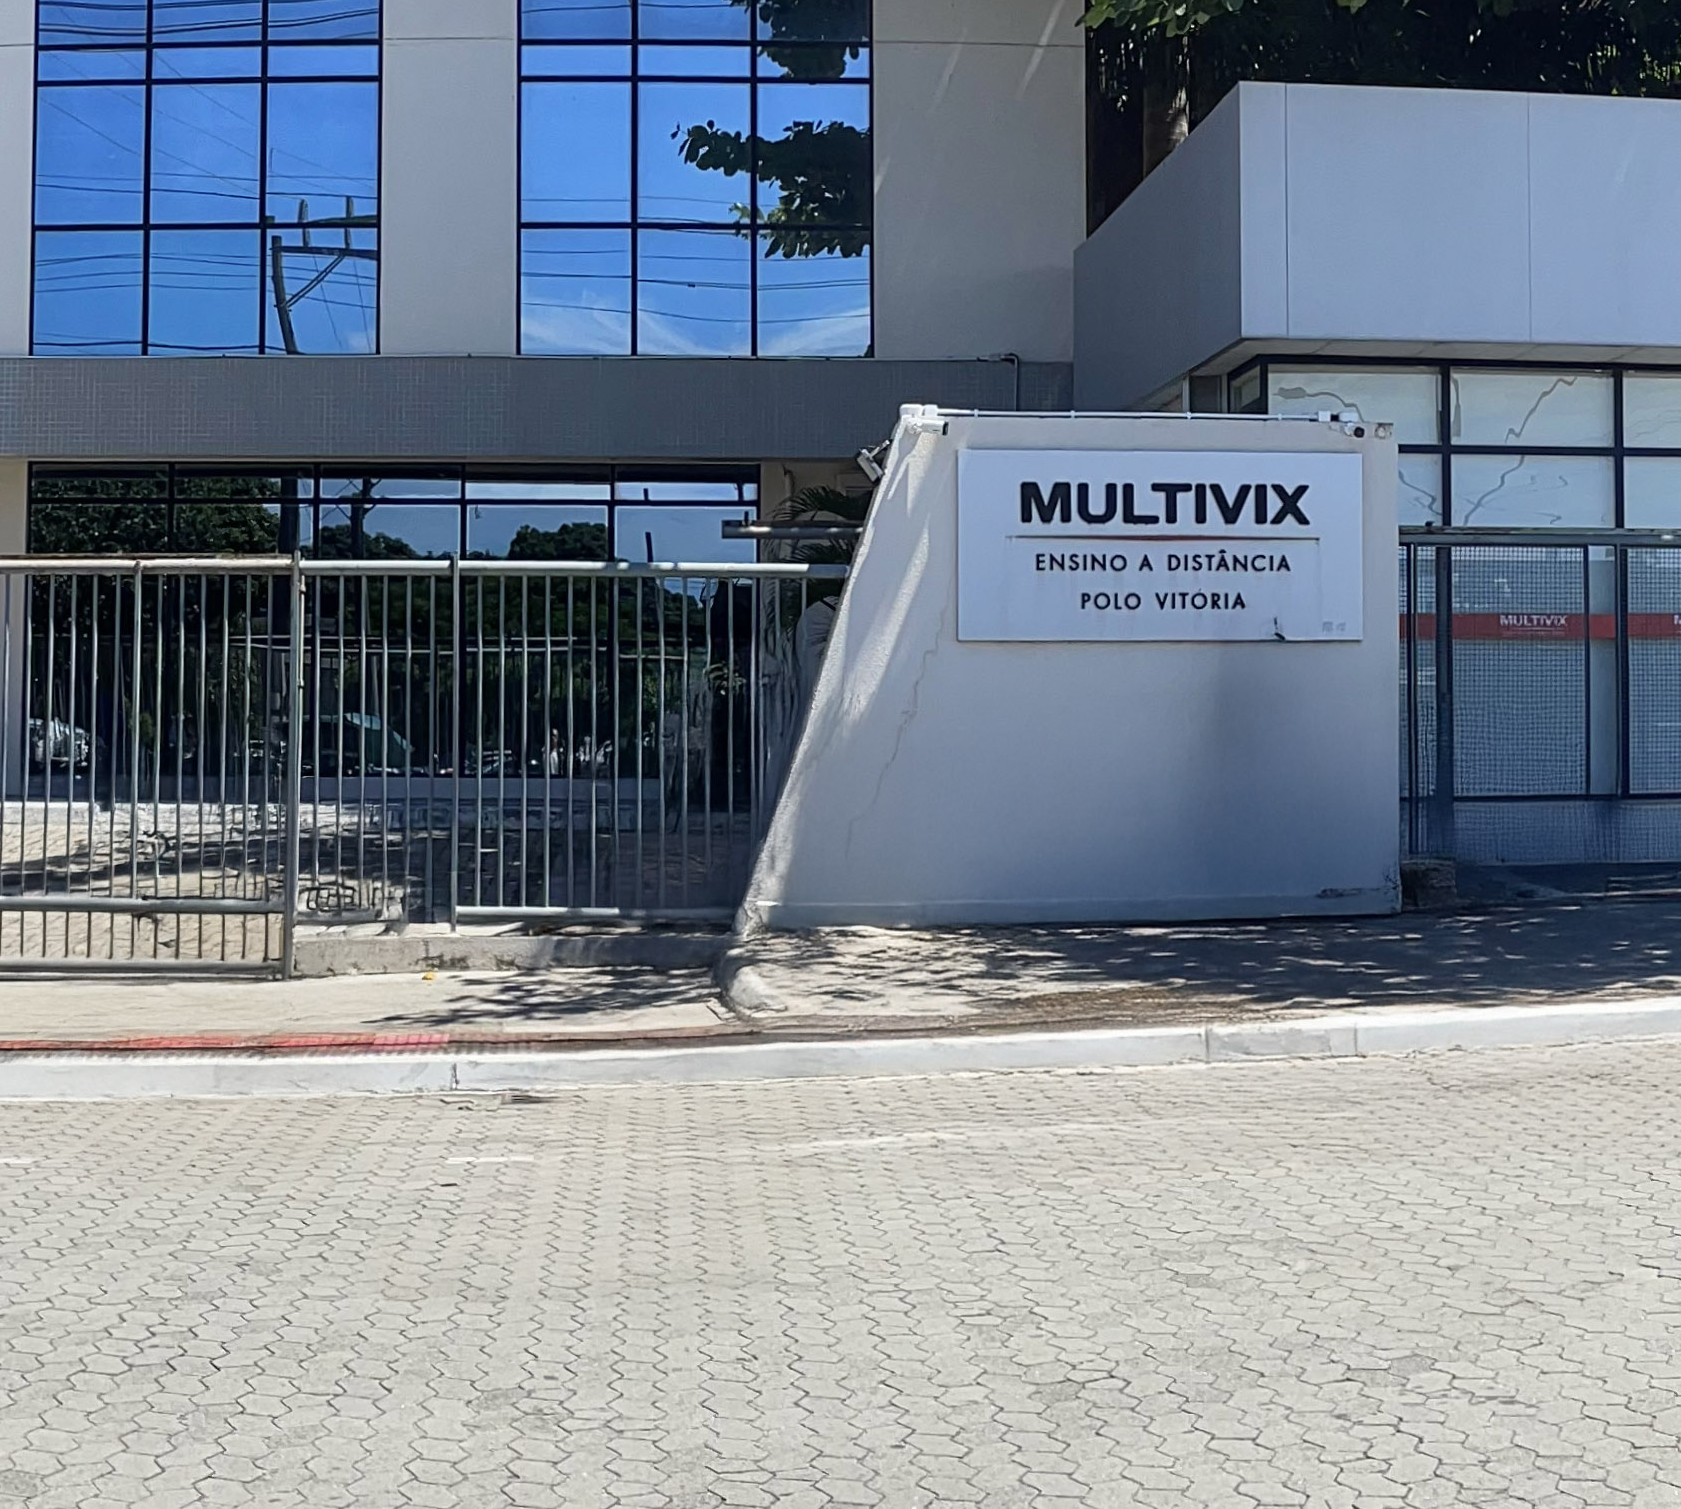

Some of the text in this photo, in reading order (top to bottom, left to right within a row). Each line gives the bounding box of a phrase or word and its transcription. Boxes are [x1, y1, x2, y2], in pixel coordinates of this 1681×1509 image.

[1020, 481, 1311, 526] MULTIVIX
[1035, 549, 1292, 572] ENSINO A DISTÂNCIA
[1080, 588, 1247, 610] POLO VITÓRIA
[1499, 614, 1568, 627] MULTIVIX
